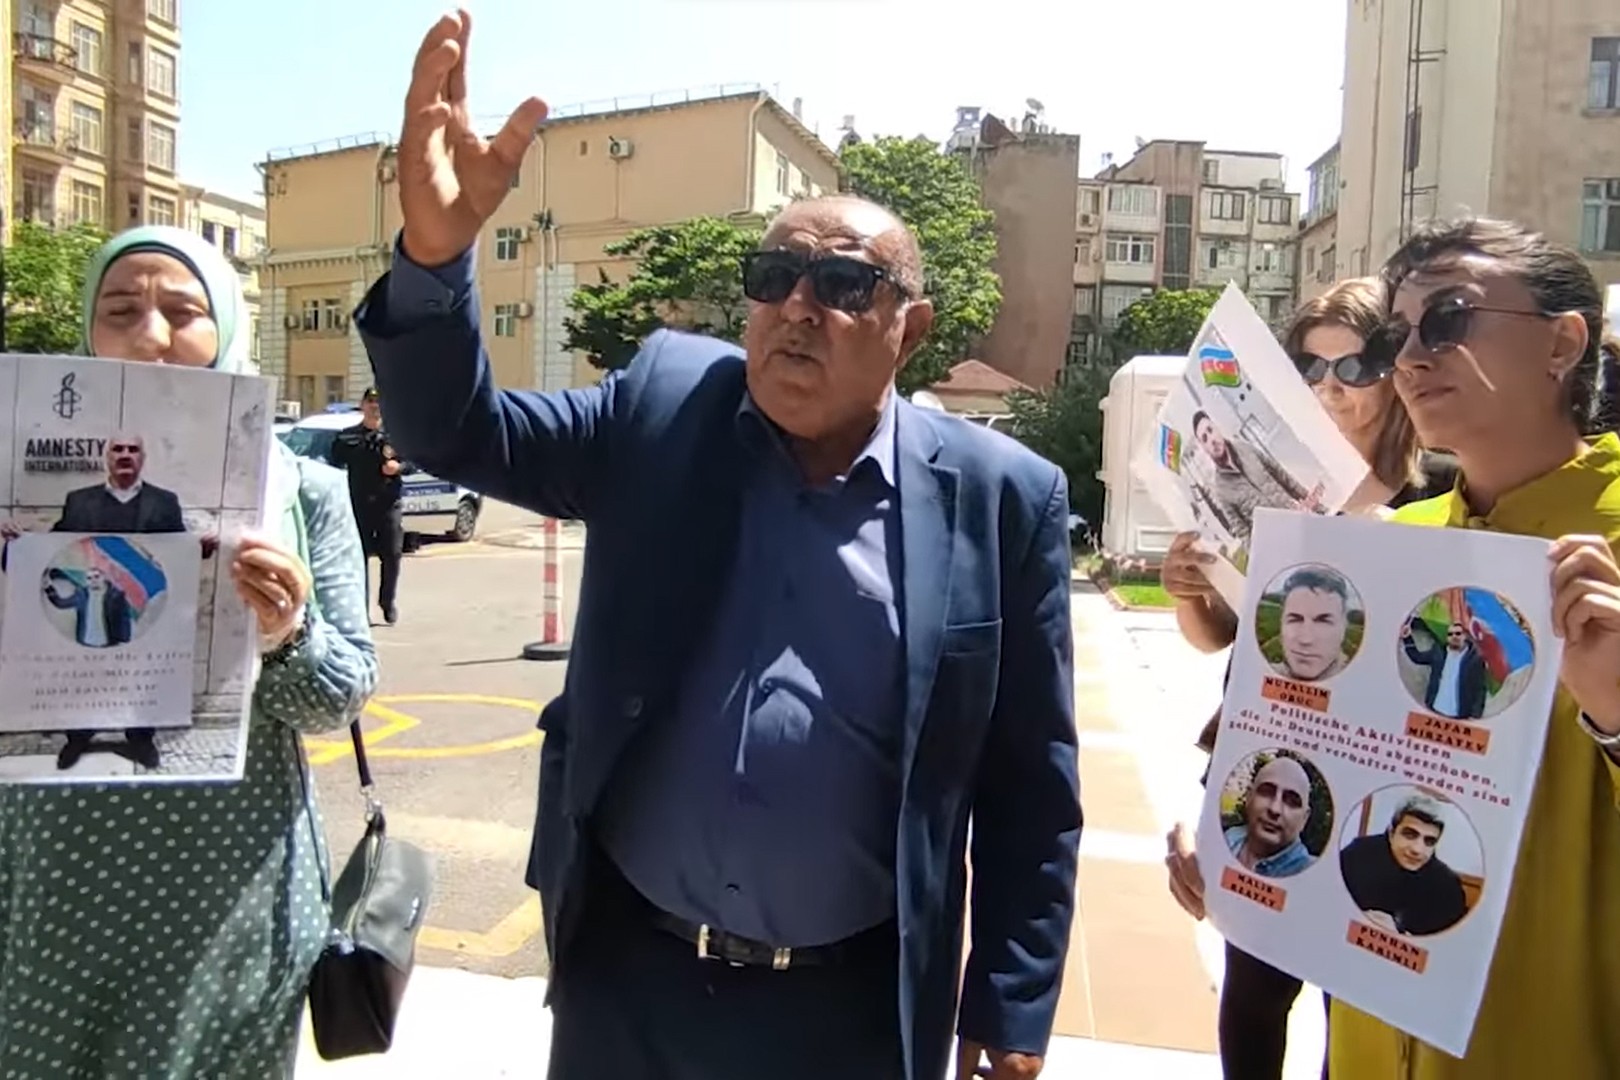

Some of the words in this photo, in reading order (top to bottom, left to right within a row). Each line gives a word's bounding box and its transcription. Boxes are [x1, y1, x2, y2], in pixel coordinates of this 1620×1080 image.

[25, 438, 106, 457] AMNESTY
[1269, 716, 1283, 727] in
[1288, 721, 1379, 754] Deutschland
[1386, 749, 1497, 789] abgeschoben,
[1270, 703, 1349, 732] Politische
[1355, 726, 1451, 759] Aktivisten
[1293, 738, 1319, 752] und
[1403, 769, 1466, 794] worden
[1472, 789, 1511, 807] sind
